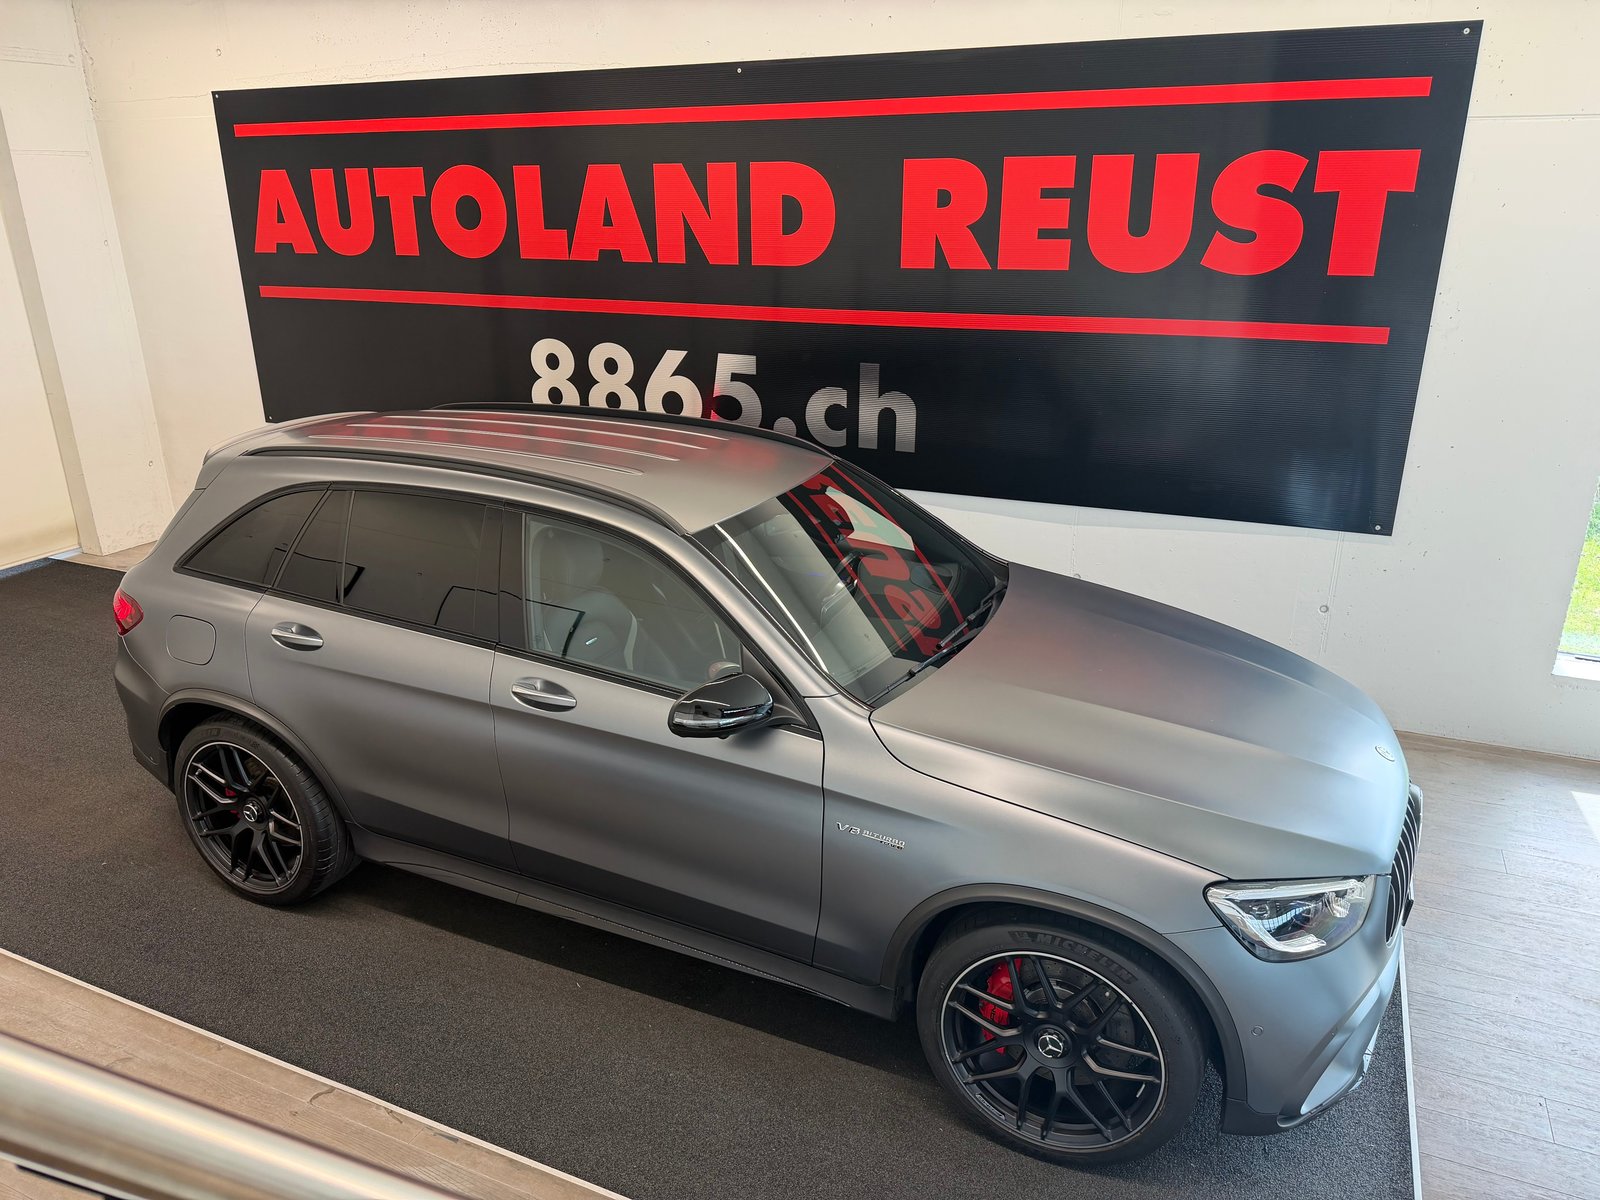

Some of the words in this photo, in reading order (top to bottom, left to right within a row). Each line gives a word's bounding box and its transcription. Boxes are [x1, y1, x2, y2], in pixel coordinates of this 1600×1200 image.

[254, 161, 836, 267] AUTOLAND
[900, 149, 1422, 277] REUST
[530, 337, 918, 453] 8865.ch
[1036, 933, 1134, 983] MICHELIN
